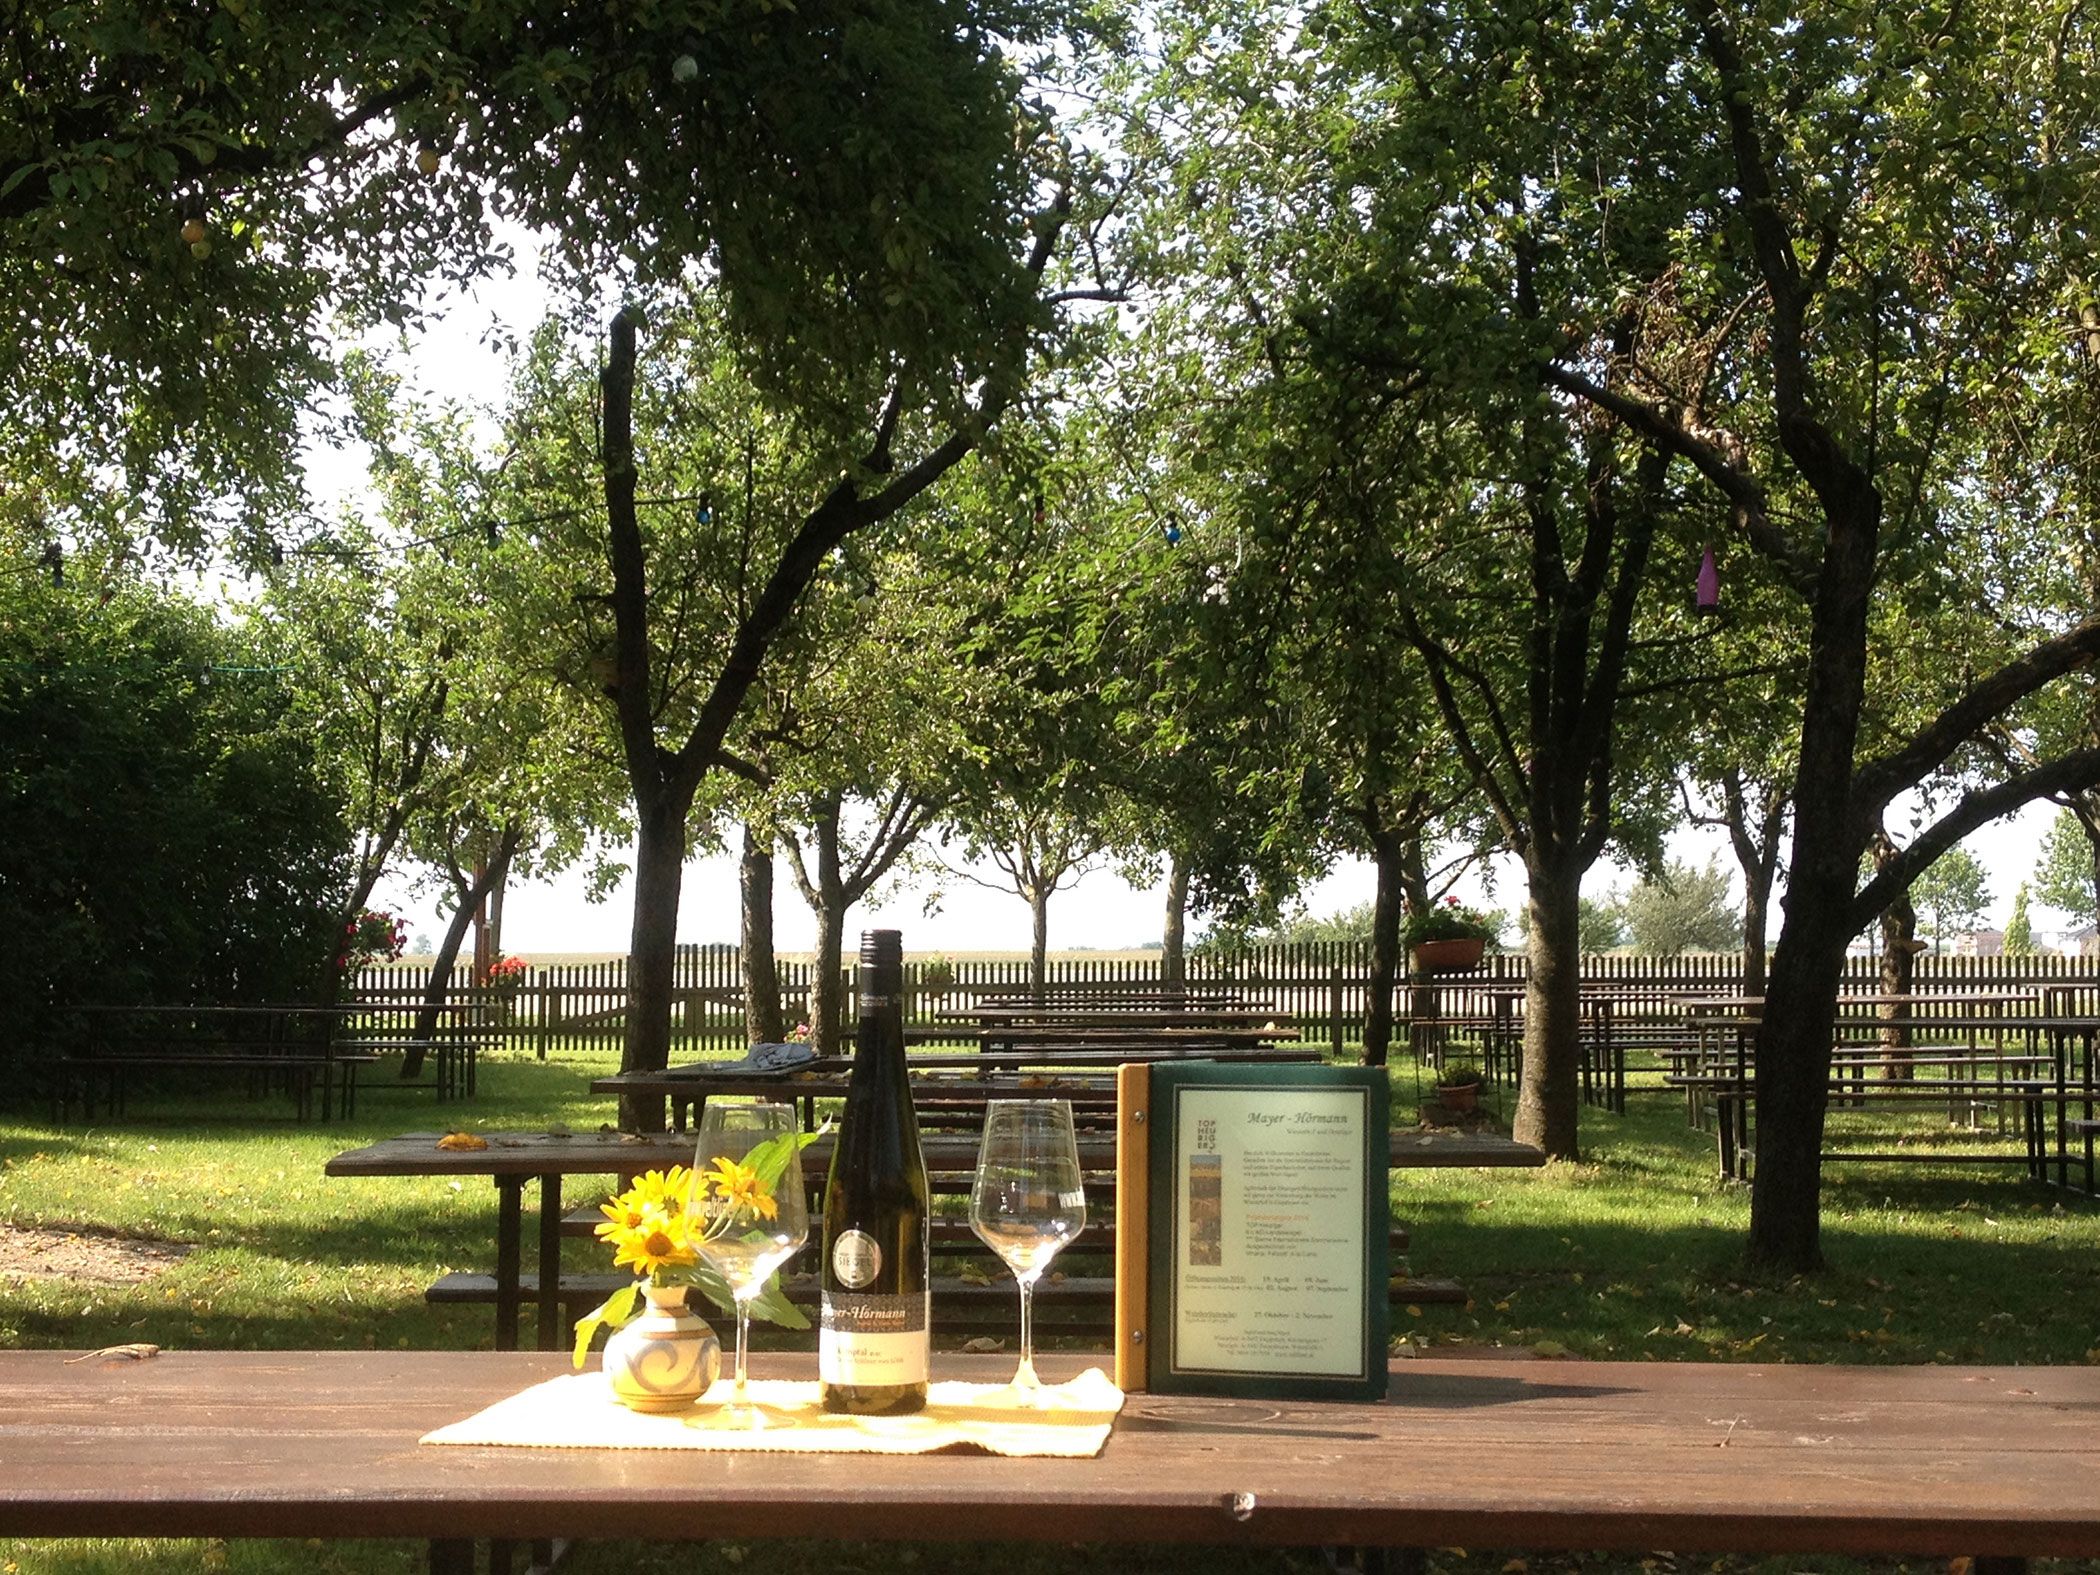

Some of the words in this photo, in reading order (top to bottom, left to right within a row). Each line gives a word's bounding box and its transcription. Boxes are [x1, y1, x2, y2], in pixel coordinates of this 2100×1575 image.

[1247, 1111, 1285, 1127] Mayer
[1294, 1111, 1348, 1125] Hörmann
[823, 1304, 906, 1320] yer-Hörmann
